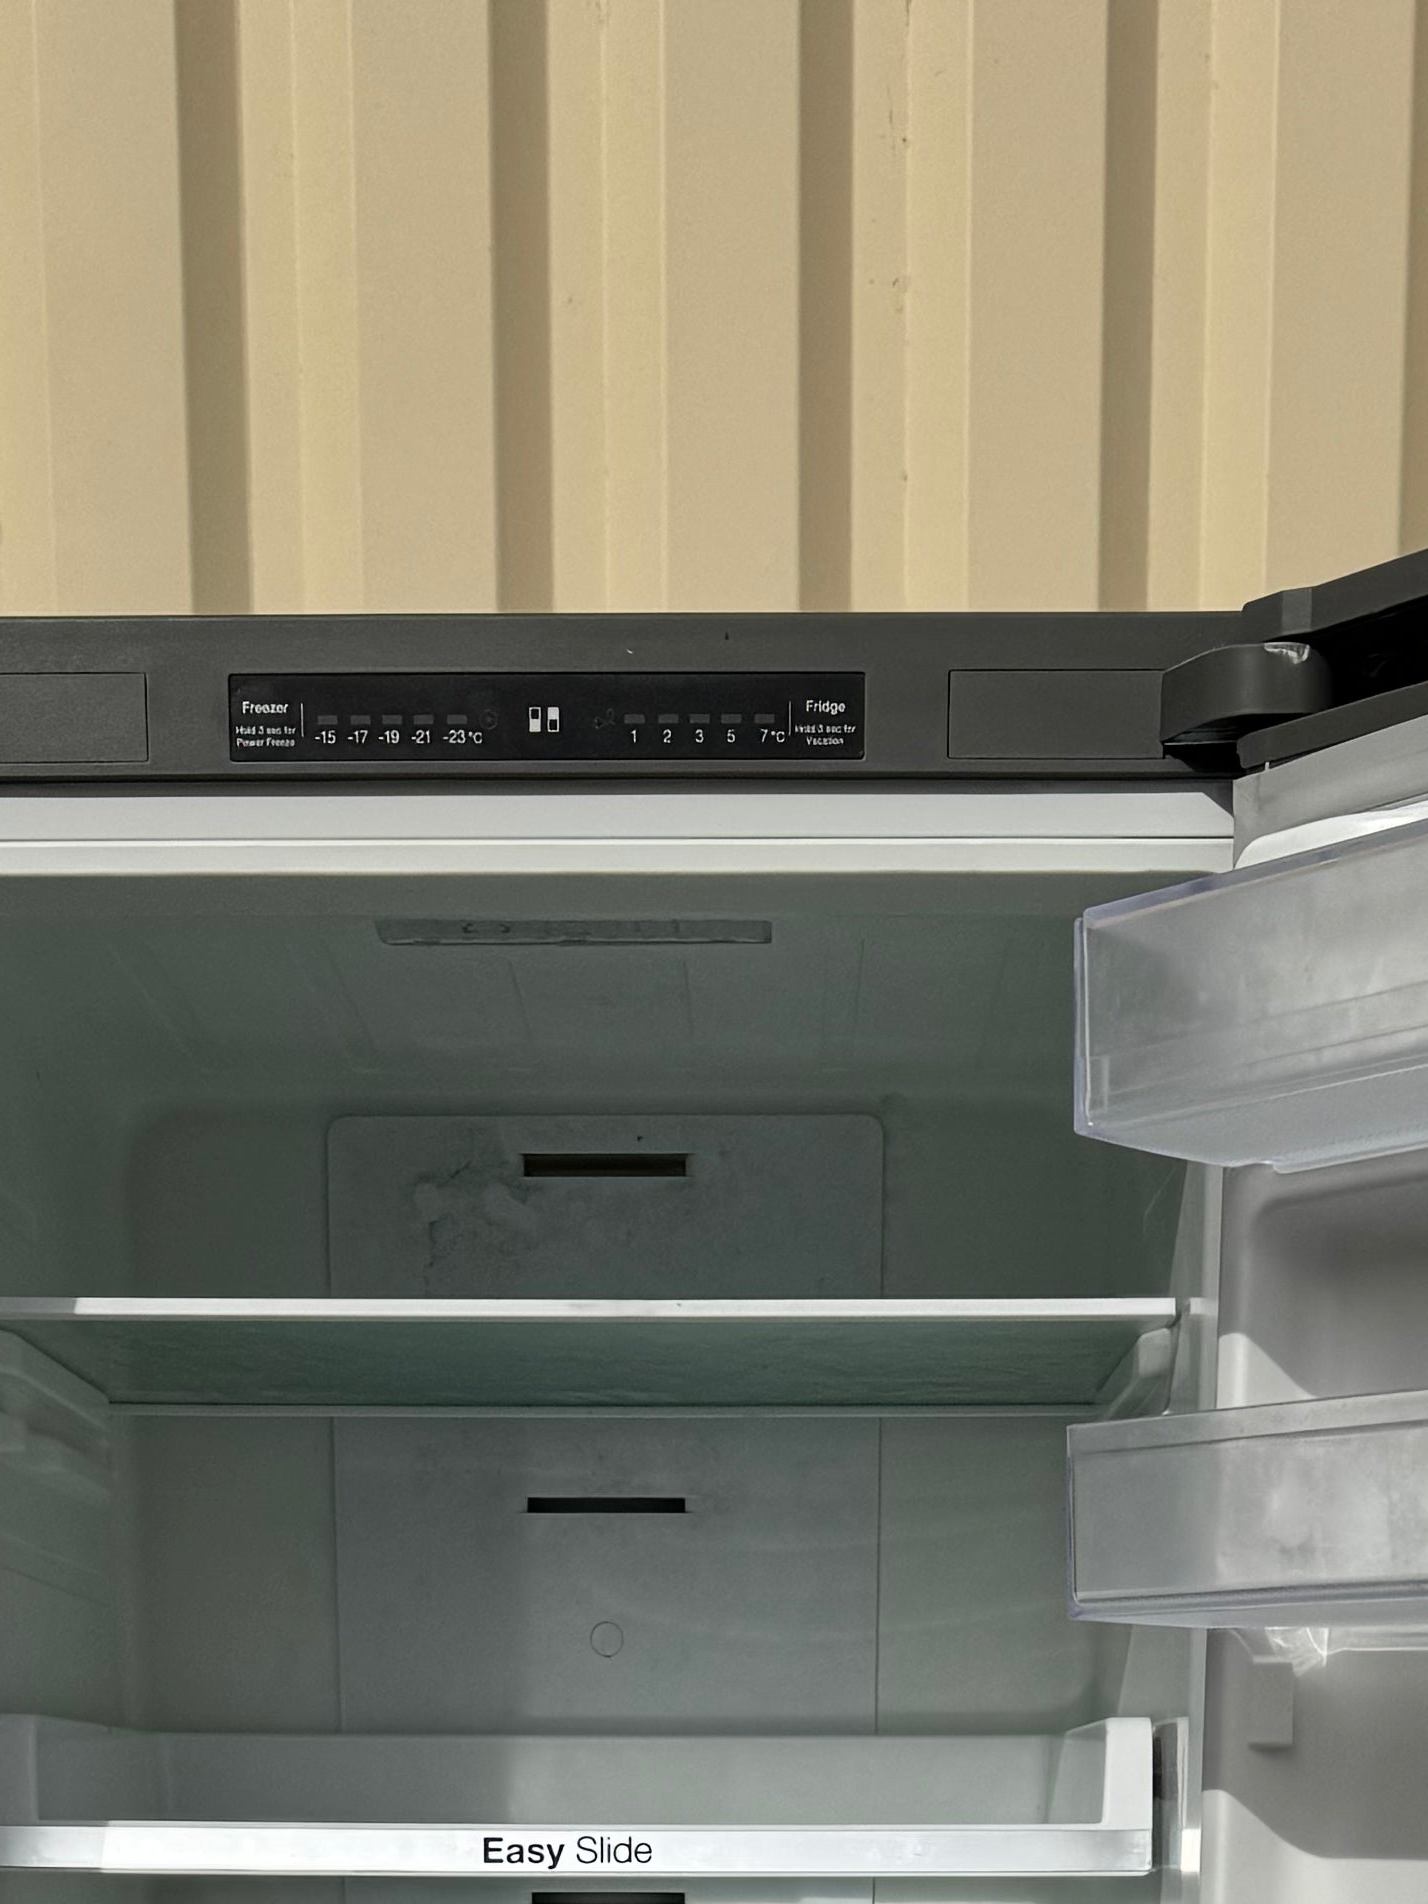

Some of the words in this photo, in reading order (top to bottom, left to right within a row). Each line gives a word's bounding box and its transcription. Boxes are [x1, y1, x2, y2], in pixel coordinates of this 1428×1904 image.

[806, 699, 846, 716] Fridge
[314, 730, 336, 744] -15
[347, 730, 368, 744] -17
[378, 730, 400, 744] -19
[411, 730, 431, 744] -21
[630, 729, 637, 743] 1
[663, 729, 672, 744] 2
[695, 729, 704, 744] 3
[727, 729, 736, 744] 5
[483, 1837, 565, 1870] Easy
[576, 1836, 653, 1864] Slide
